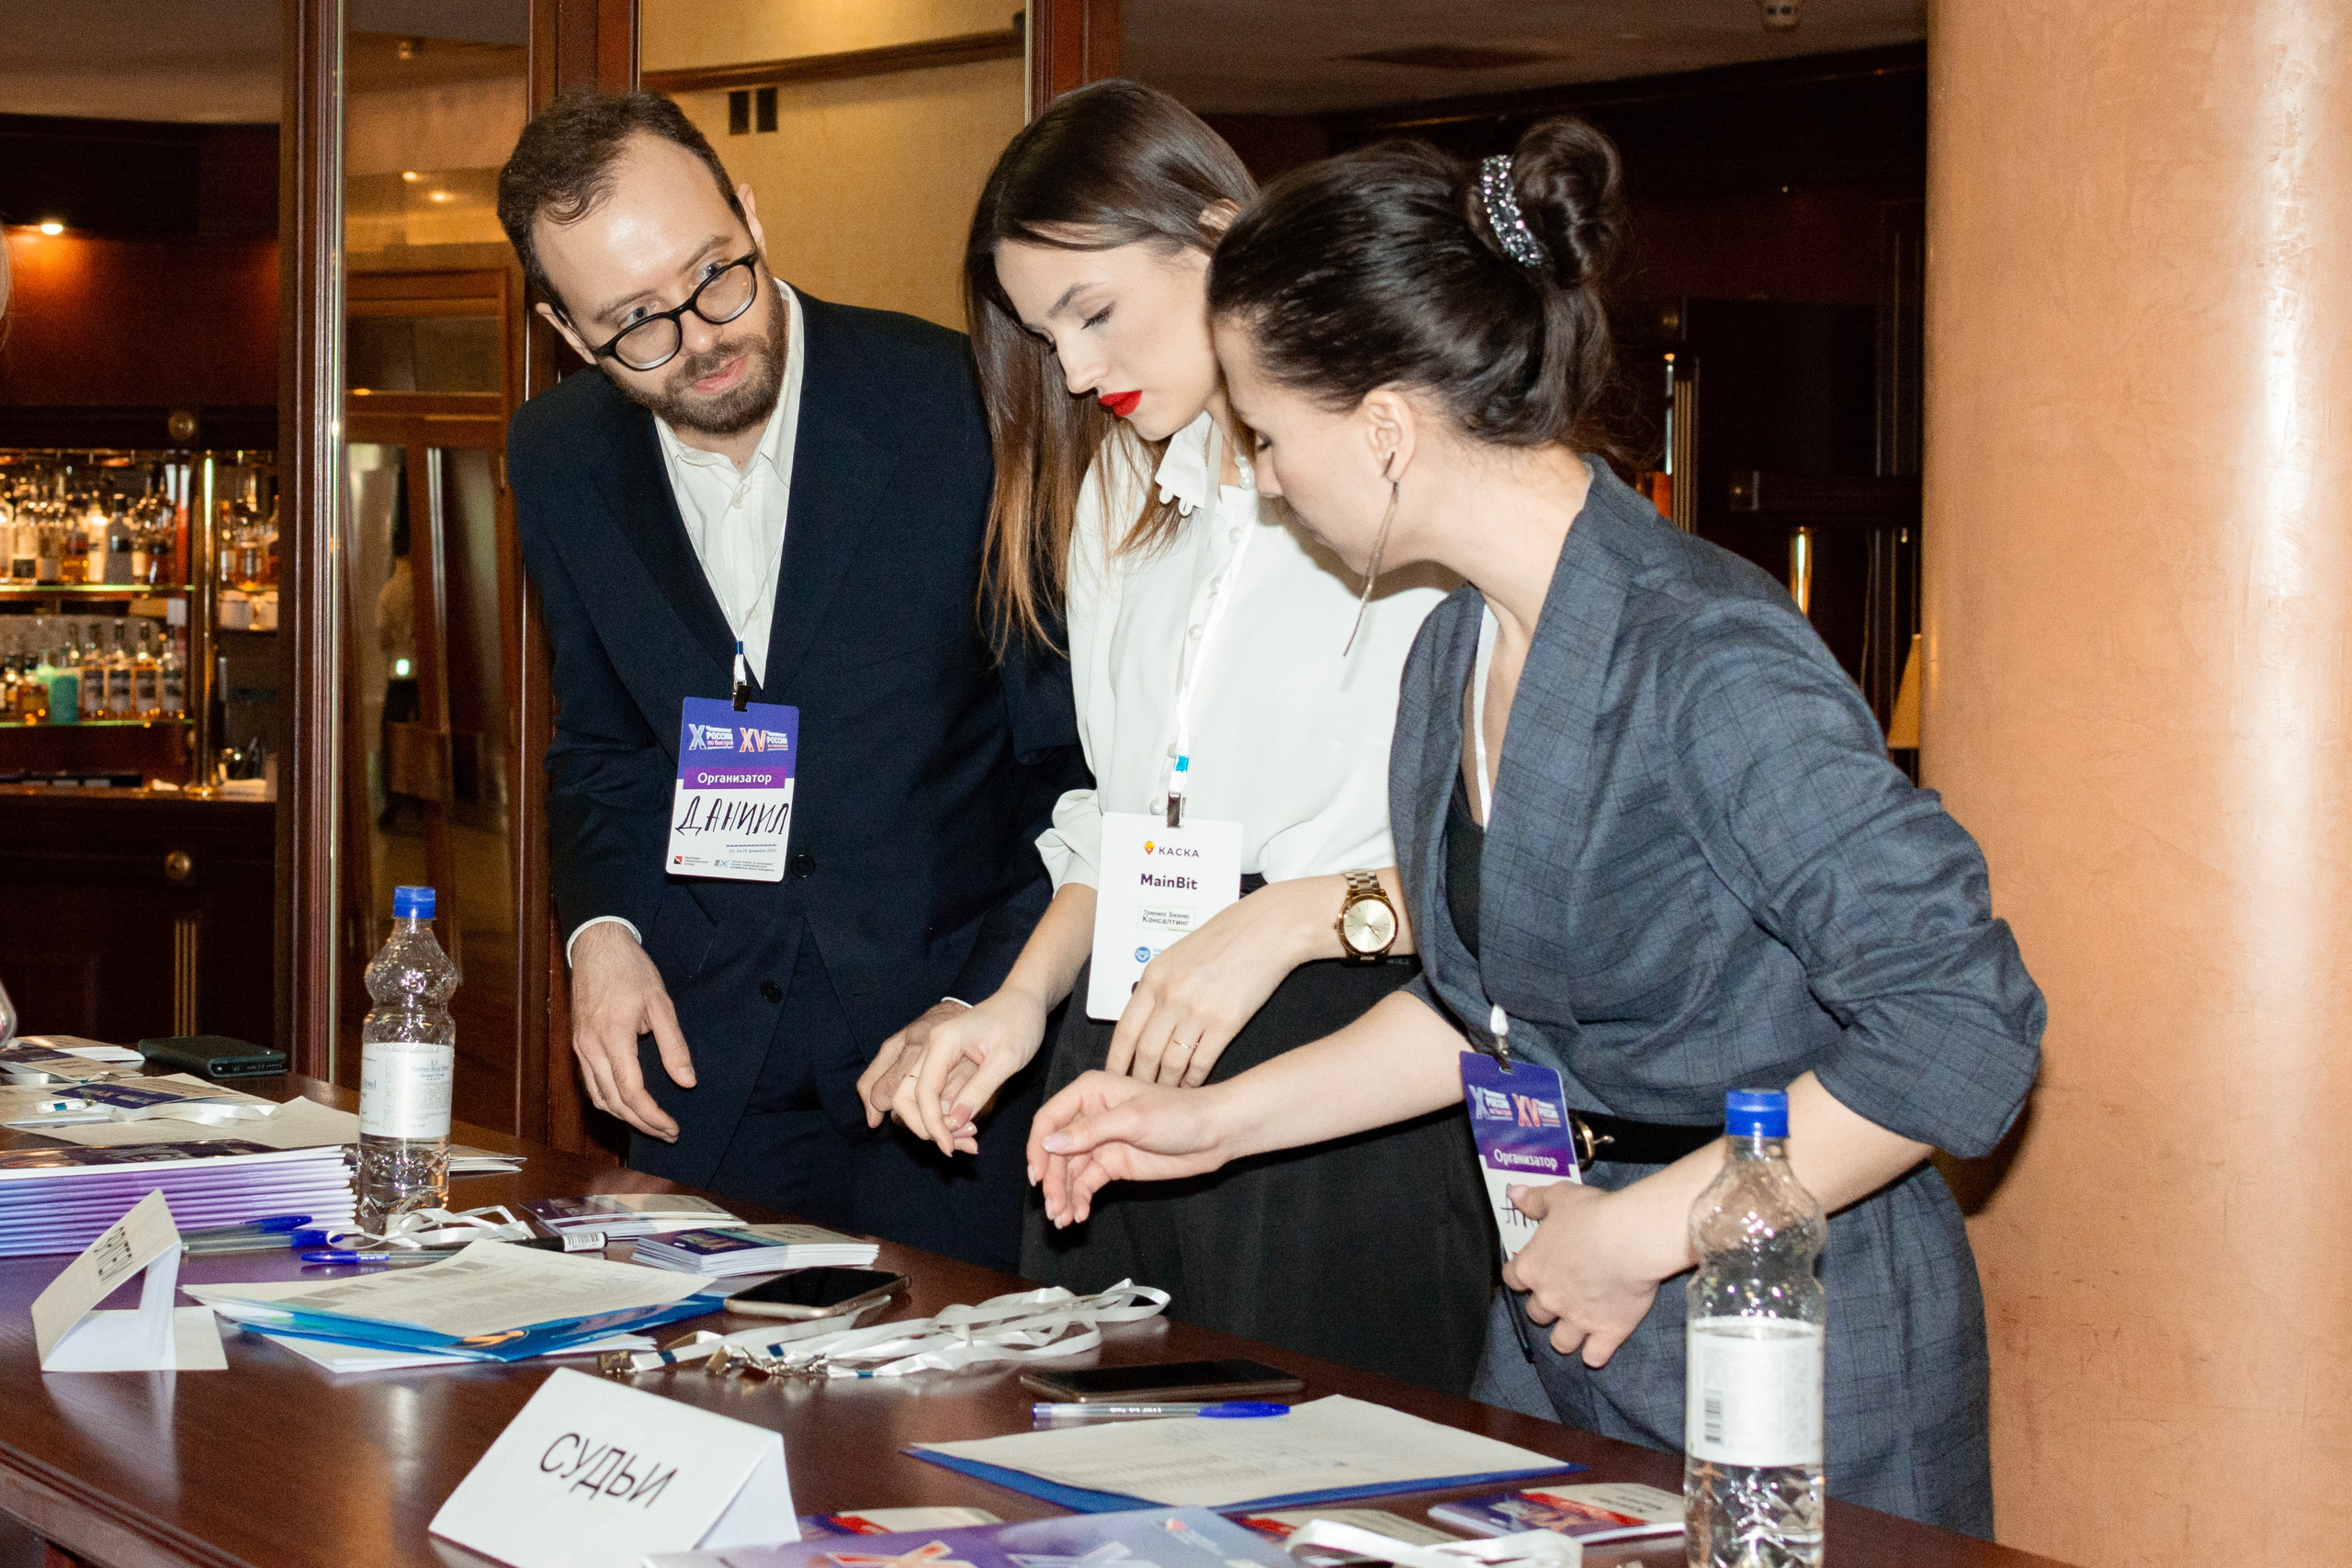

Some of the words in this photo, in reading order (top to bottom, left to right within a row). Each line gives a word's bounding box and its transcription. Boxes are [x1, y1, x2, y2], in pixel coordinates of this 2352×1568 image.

[688, 723, 707, 750] X
[739, 727, 767, 752] XV
[697, 773, 772, 785] Организатор
[675, 795, 789, 836] ДАНИИЛ
[1140, 874, 1198, 890] MainBit
[1142, 916, 1190, 926] Консалтинг
[1494, 1148, 1558, 1171] Организатор
[539, 1432, 678, 1508] СУДЬИ
